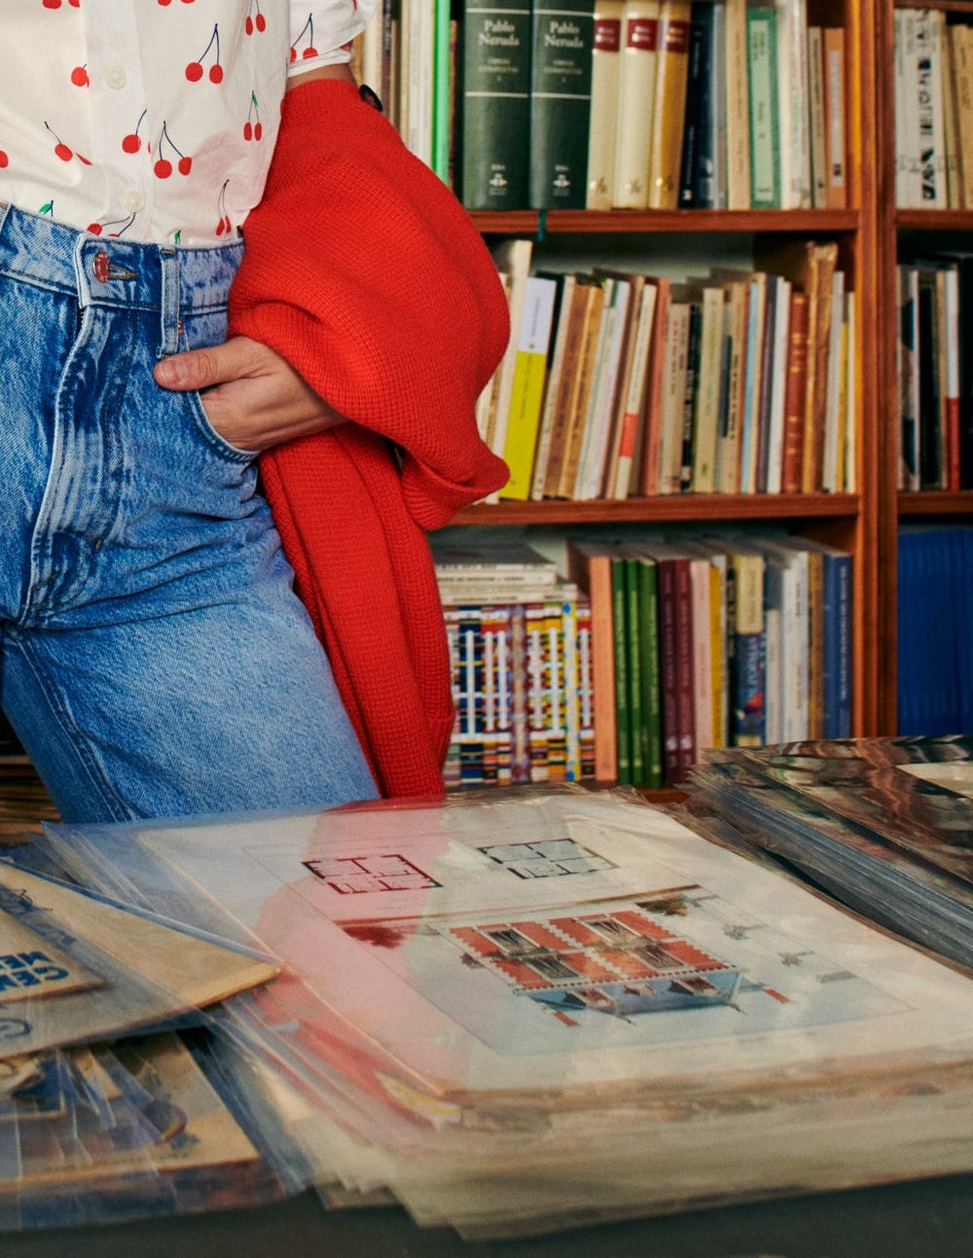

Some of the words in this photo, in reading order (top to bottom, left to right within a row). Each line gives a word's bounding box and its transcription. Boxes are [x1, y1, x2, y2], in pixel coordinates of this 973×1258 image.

[484, 20, 516, 33] Pablo
[550, 21, 580, 34] Pablo
[478, 33, 520, 47] Neruda
[544, 34, 584, 48] Neruda
